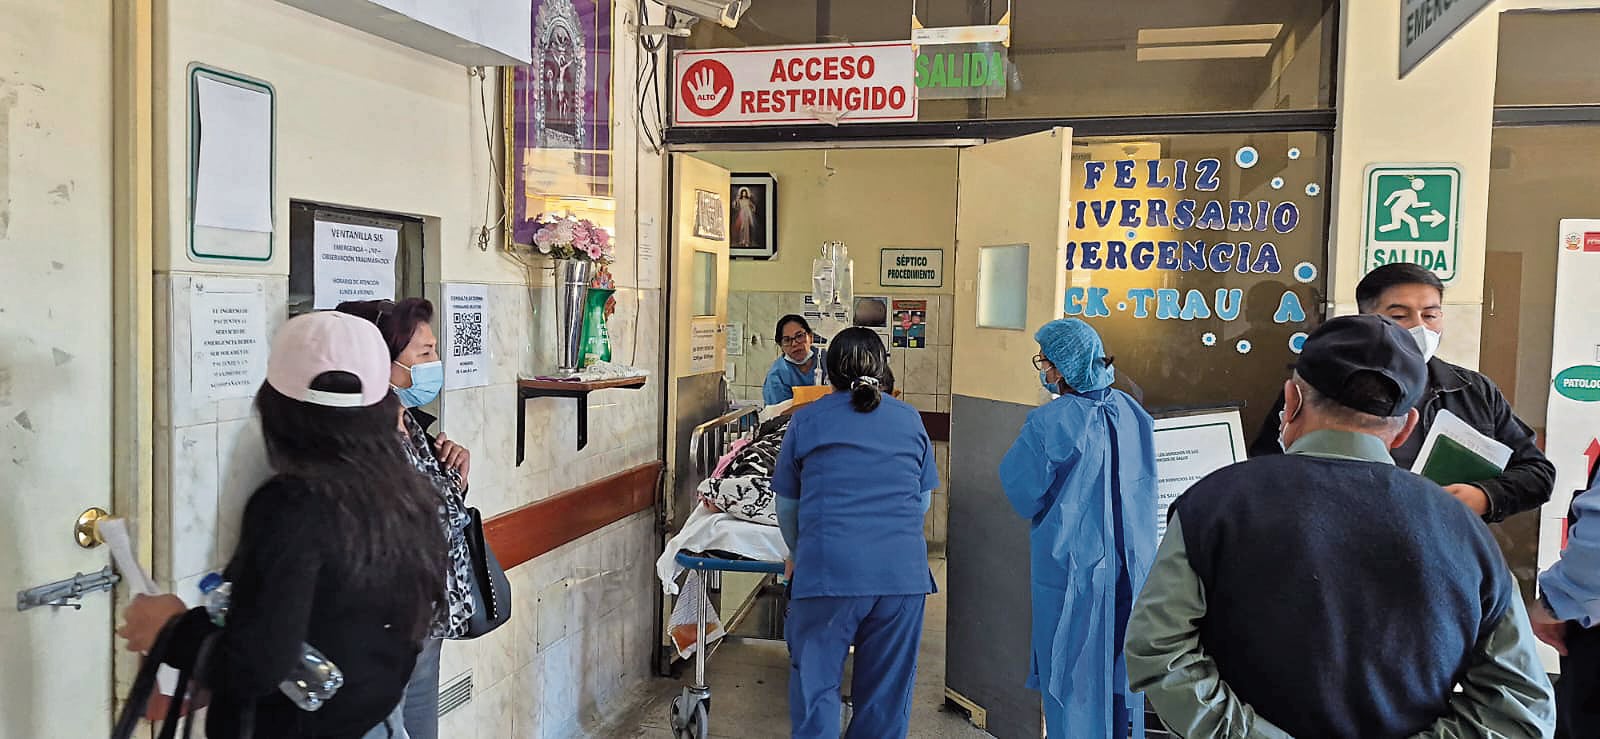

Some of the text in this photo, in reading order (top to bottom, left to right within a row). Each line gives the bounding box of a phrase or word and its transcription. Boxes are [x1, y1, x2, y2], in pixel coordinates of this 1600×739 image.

[770, 55, 875, 83] ACCESO
[914, 51, 1005, 89] SALIDA
[740, 85, 906, 114] RESTRINGIDO
[1082, 158, 1221, 192] FELIZ
[1067, 198, 1300, 234] IVERSARIO
[331, 228, 383, 242] VENTANILLA SIS
[887, 269, 936, 280] PROCEDIMIENTO
[896, 254, 928, 267] SÉPTICO
